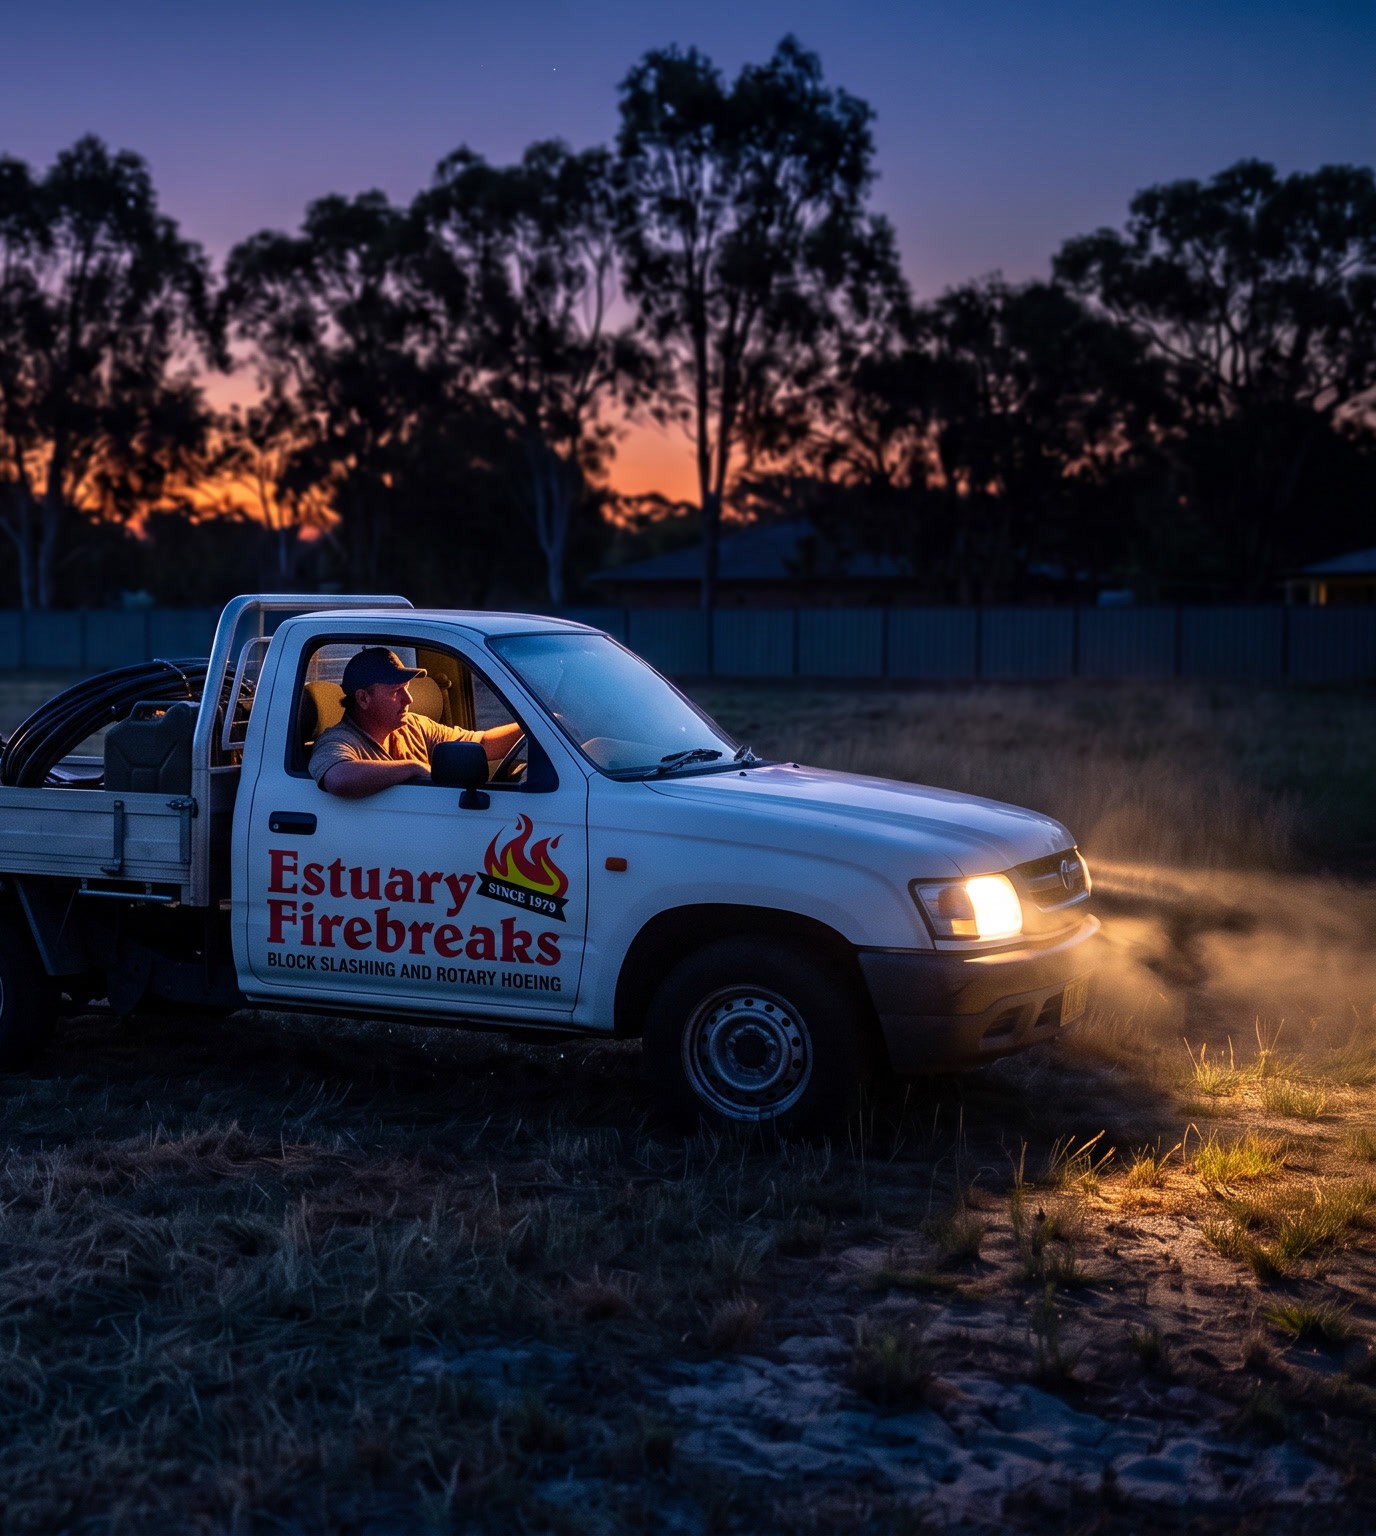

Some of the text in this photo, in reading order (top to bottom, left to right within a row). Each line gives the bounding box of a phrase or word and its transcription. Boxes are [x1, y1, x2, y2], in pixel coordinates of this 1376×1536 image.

[267, 849, 476, 917] Estuary
[488, 882, 556, 913] SINCE 1979
[267, 899, 562, 966] Firebreaks
[267, 952, 561, 991] BLOCK SLASHING AND ROTARY HOEING
